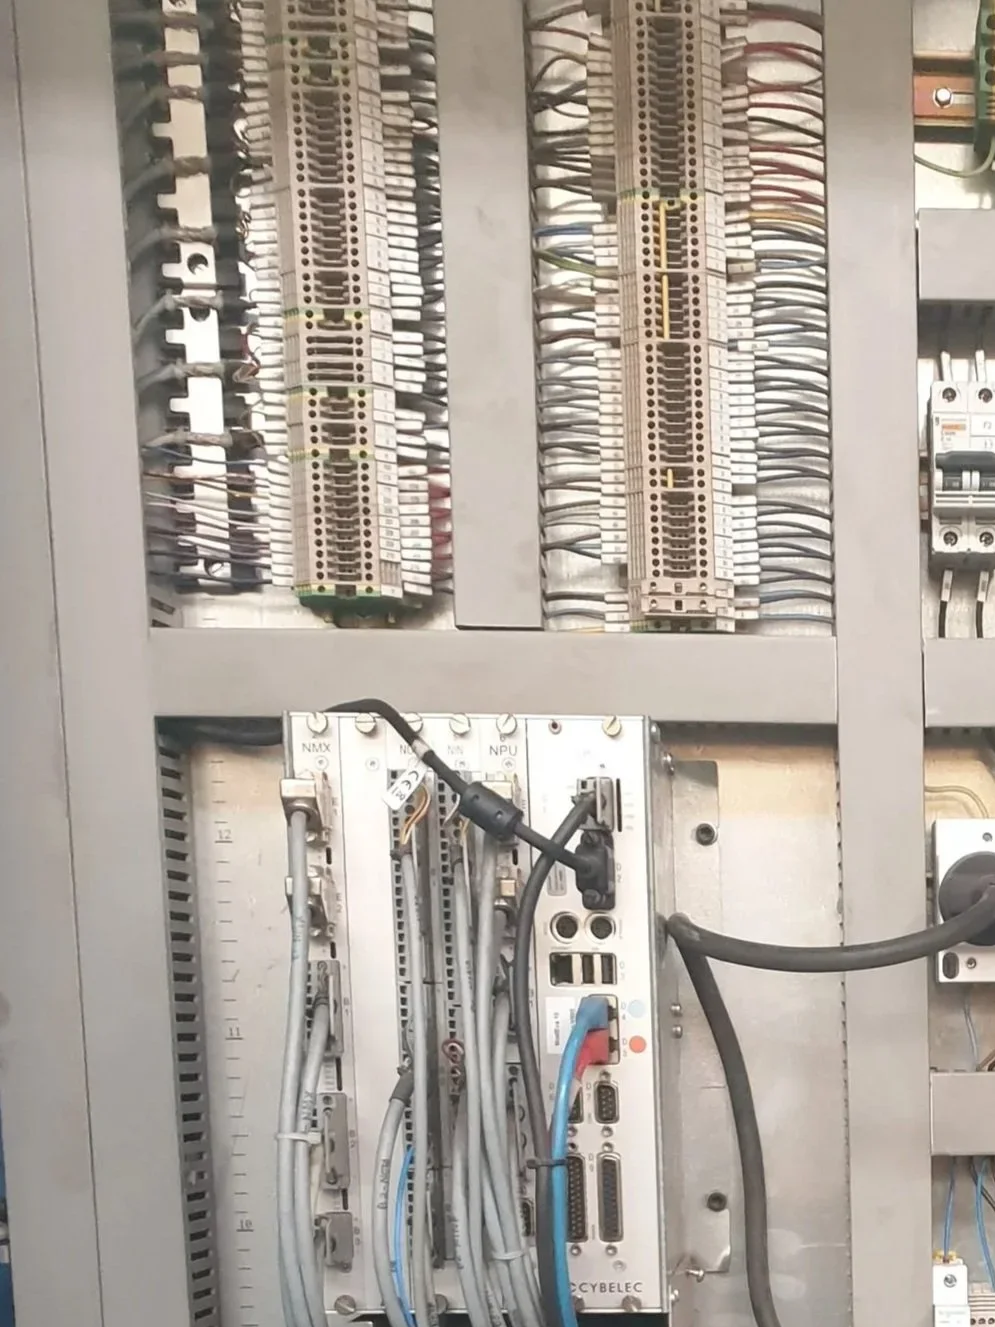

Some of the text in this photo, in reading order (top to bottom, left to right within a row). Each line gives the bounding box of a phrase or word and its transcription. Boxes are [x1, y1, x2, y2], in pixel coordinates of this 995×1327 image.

[301, 742, 331, 754] NMX
[489, 745, 518, 756] NPU
[217, 829, 231, 840] 12
[229, 1027, 240, 1037] 11
[240, 1219, 253, 1229] 10
[578, 1282, 643, 1293] CYBELEC
